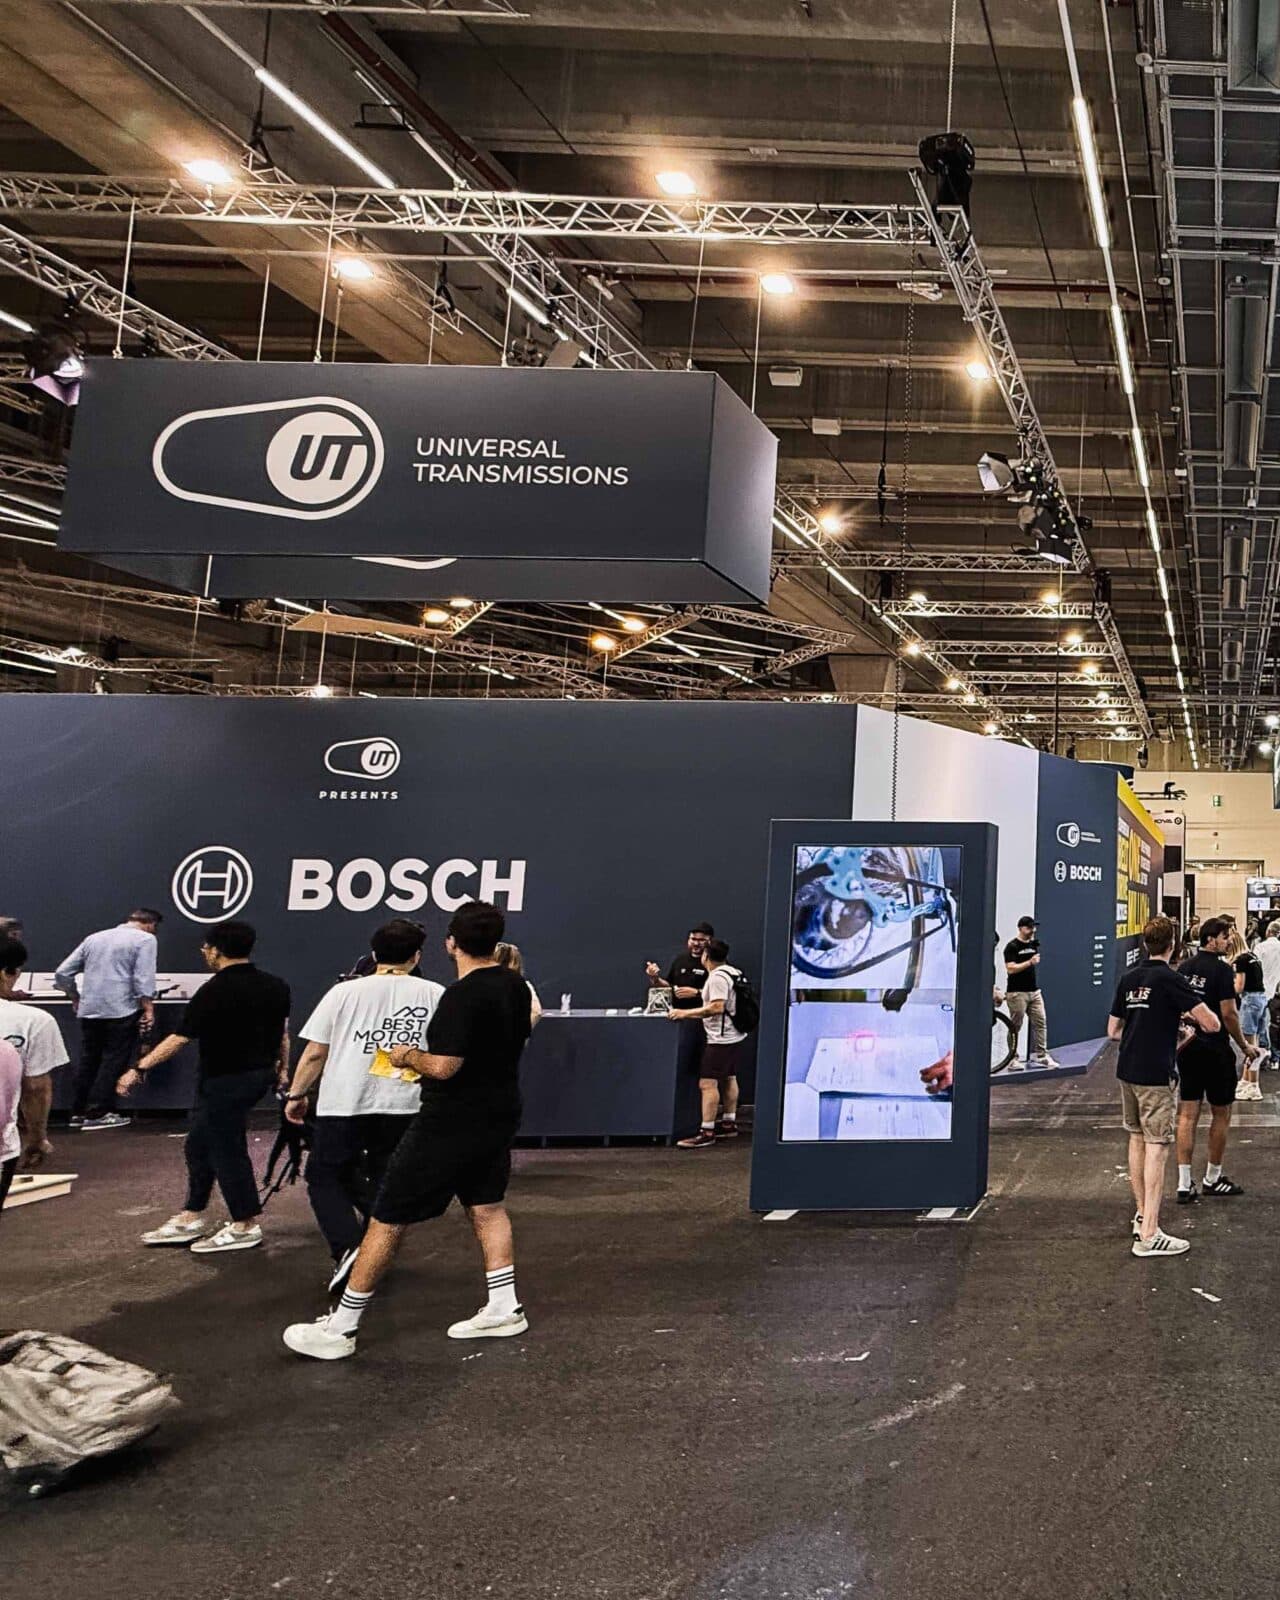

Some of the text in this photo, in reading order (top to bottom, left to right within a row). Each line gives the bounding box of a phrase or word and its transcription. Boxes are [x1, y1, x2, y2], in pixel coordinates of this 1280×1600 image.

[415, 437, 566, 459] UNIVERSAL
[289, 434, 368, 481] UT
[413, 463, 630, 486] TRANSMISSIONS
[369, 750, 395, 767] UT
[319, 791, 399, 800] PRESENTS
[1070, 865, 1102, 882] BOSCH
[287, 858, 526, 912] BOSCH
[382, 1018, 426, 1032] BEST
[353, 1030, 423, 1043] MOTOR
